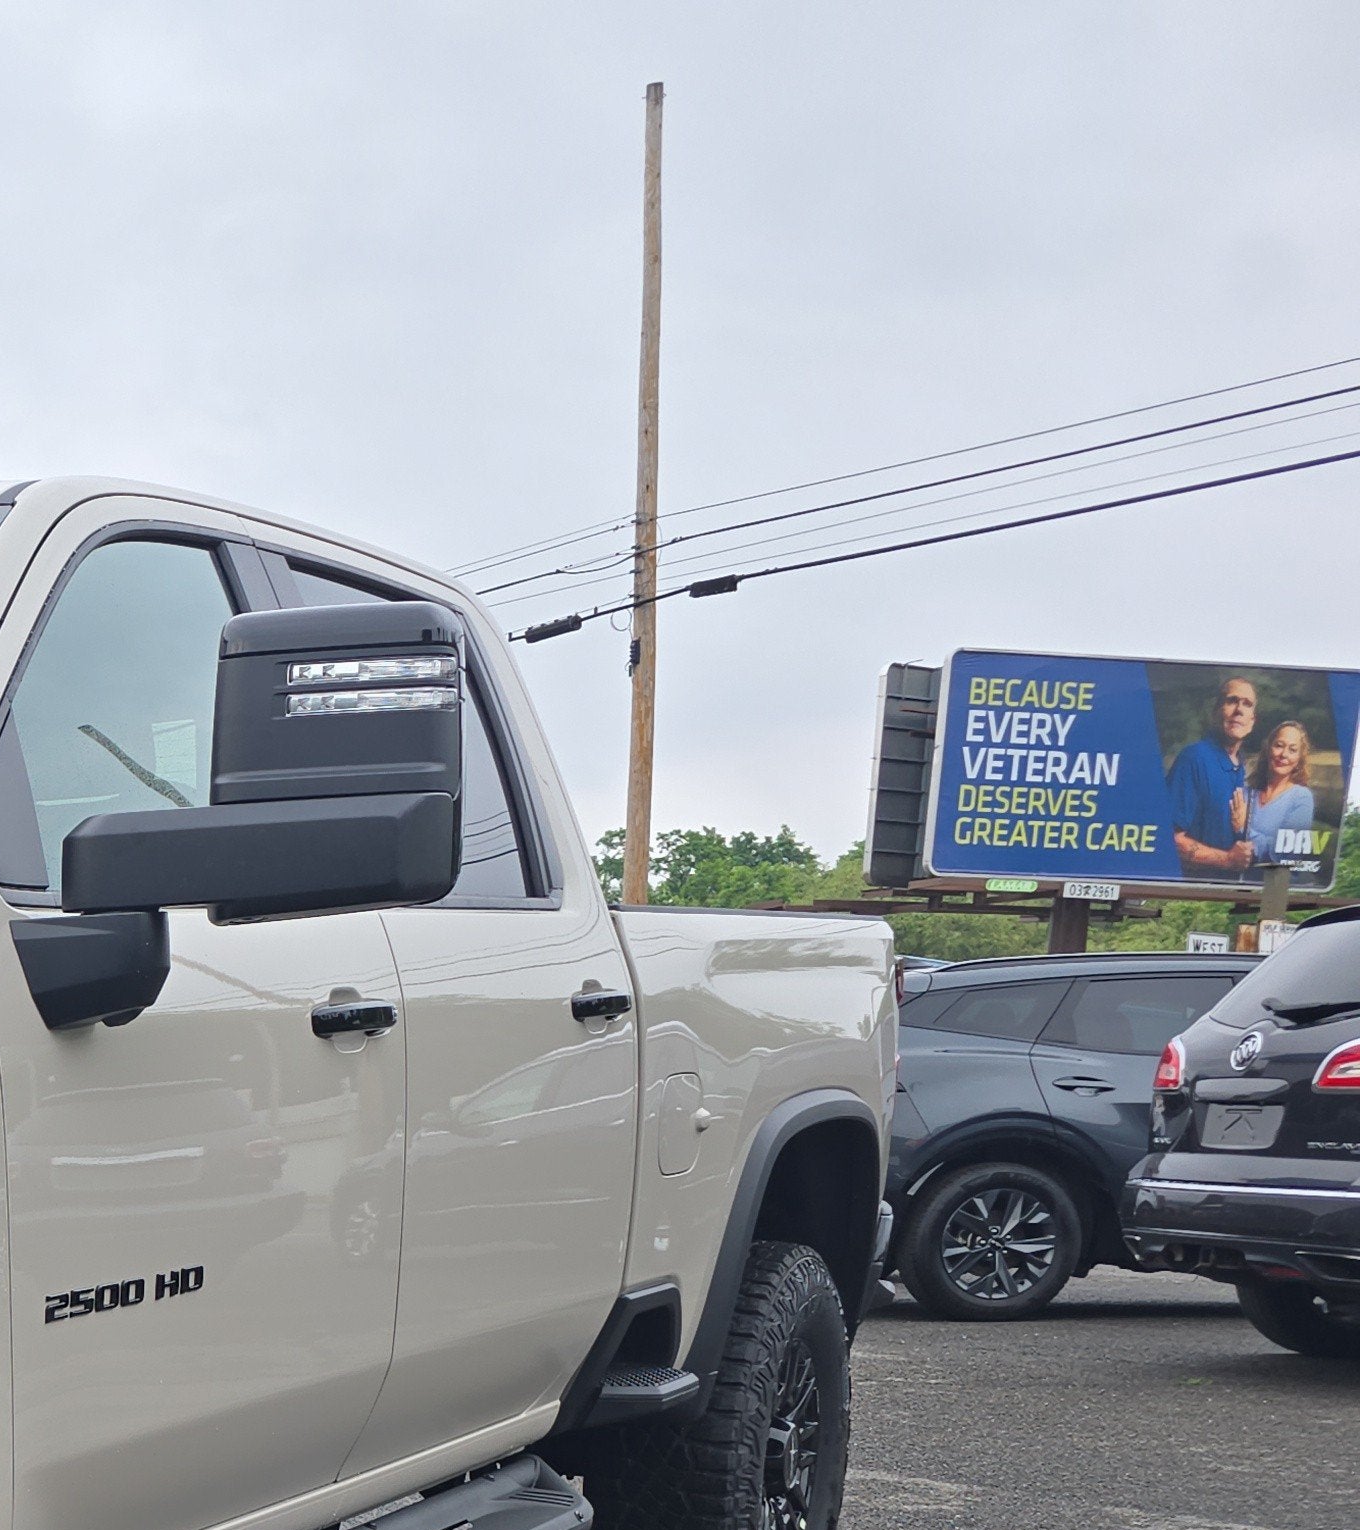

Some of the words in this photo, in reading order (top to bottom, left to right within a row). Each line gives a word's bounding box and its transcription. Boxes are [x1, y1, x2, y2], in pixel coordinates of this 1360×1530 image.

[969, 677, 1096, 711] BECAUSE
[966, 710, 1076, 746] EVERY
[962, 746, 1120, 786] VETERAN
[958, 785, 1098, 818] DESERVES
[954, 817, 1079, 850] GREATER
[1086, 822, 1157, 854] CARE
[1275, 828, 1332, 855] DAV
[1193, 938, 1224, 953] WEST
[44, 1278, 145, 1324] 2500
[155, 1265, 204, 1300] HD
